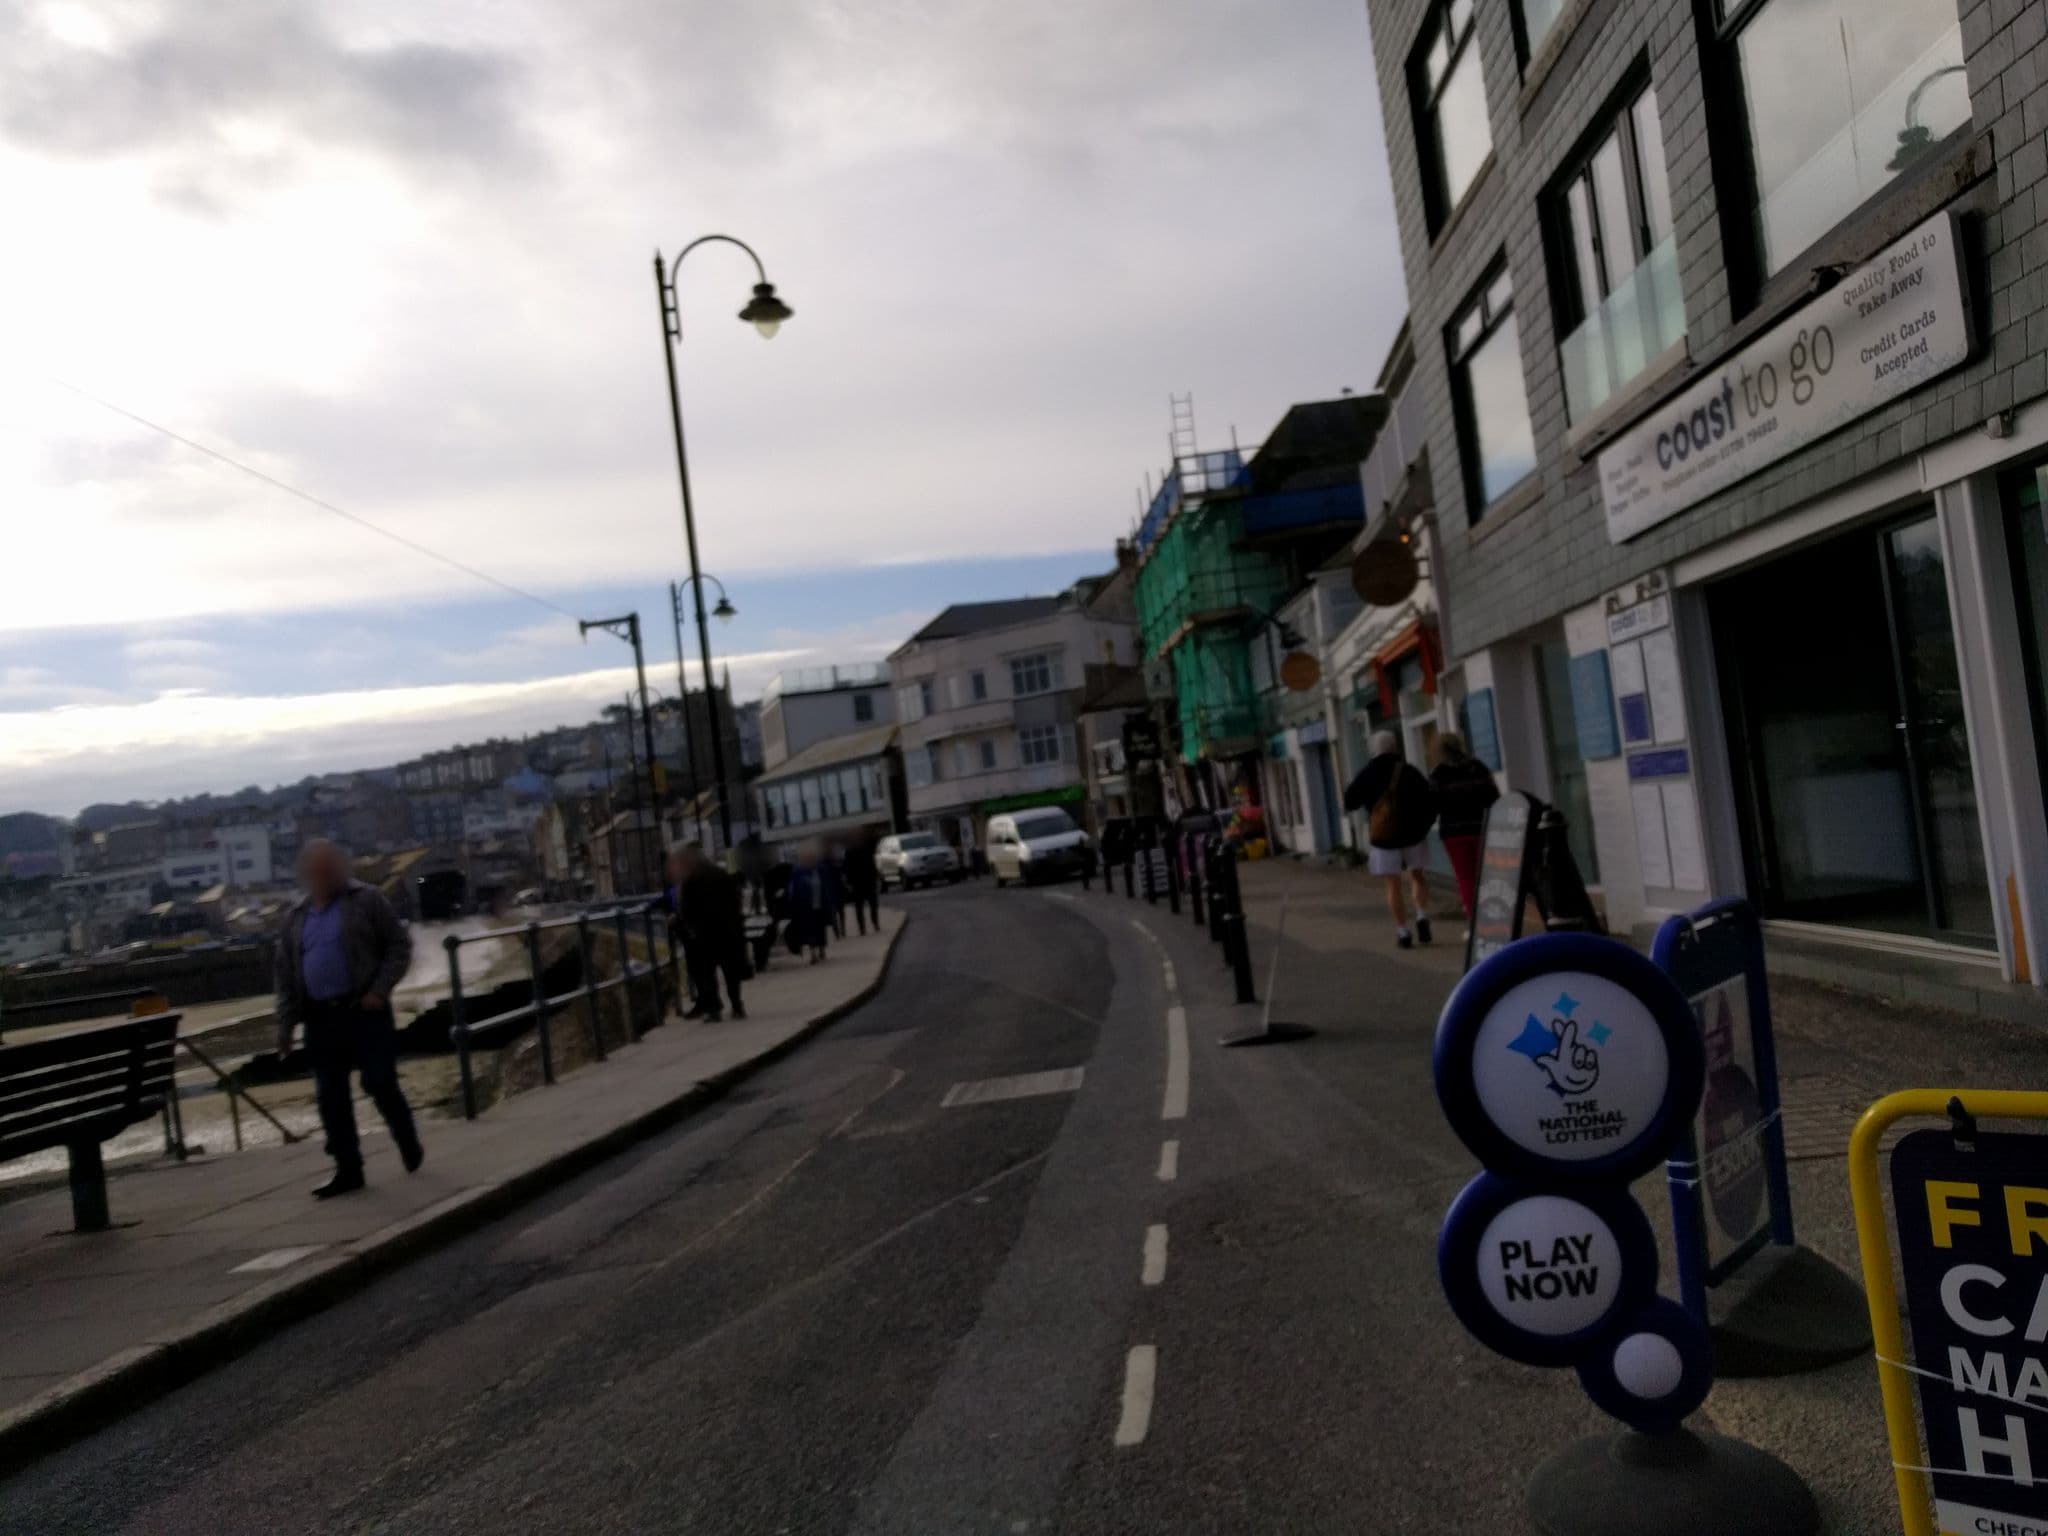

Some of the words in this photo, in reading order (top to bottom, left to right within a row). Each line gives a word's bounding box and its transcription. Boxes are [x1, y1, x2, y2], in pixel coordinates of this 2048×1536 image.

[1843, 267, 1885, 306] Quality
[1888, 242, 1919, 275] Food
[1921, 233, 1936, 252] to
[1858, 292, 1887, 319] Take
[1890, 266, 1924, 299] Away
[1860, 331, 1897, 364] Credit
[1900, 310, 1937, 340] Cards
[1874, 337, 1928, 380] Accepted
[1656, 376, 1735, 470] coast
[1740, 362, 1778, 418] to
[1790, 324, 1834, 406] go
[1538, 1110, 1626, 1130] NATIONAL
[1546, 1123, 1624, 1144] LOTTERY
[1563, 1100, 1599, 1115] THE
[1925, 1179, 2048, 1257] FR
[1499, 1233, 1592, 1269] PLAY
[1504, 1266, 1599, 1301] NOW
[1940, 1263, 2048, 1343] C
[1957, 1406, 2034, 1488] H
